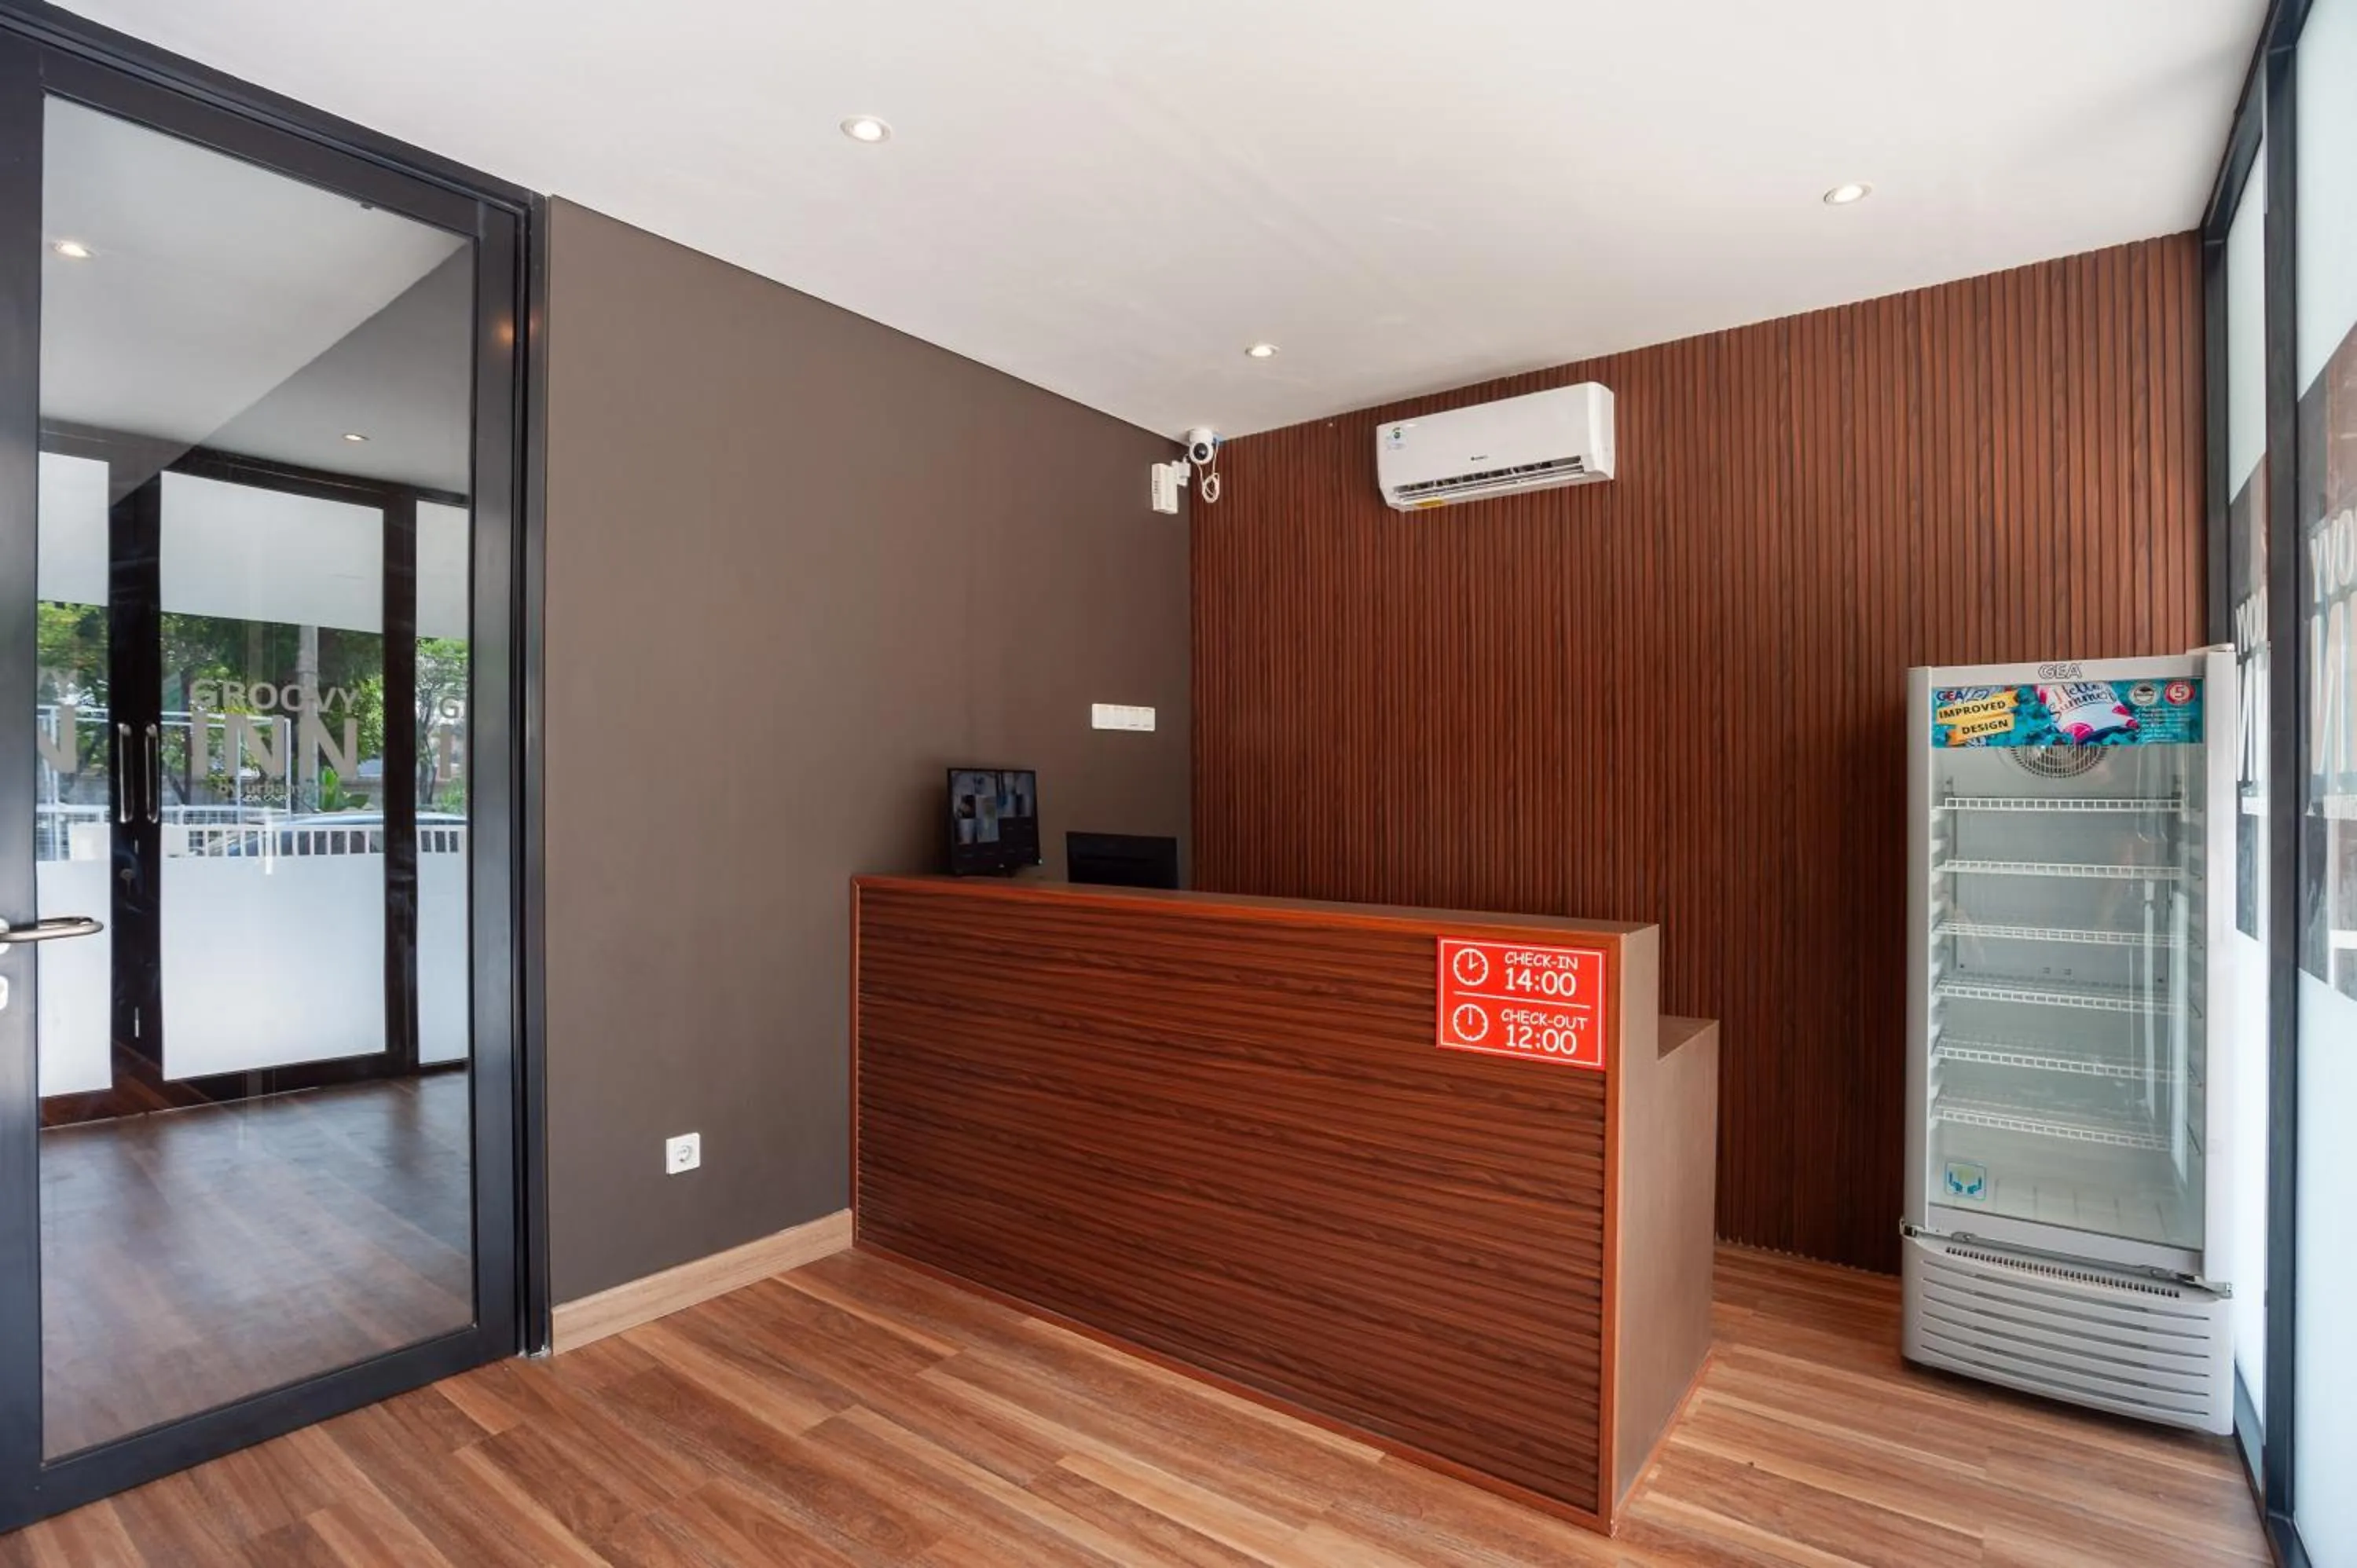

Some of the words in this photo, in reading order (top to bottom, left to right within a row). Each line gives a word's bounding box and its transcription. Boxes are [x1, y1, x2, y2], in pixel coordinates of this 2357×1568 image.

[2037, 662, 2084, 680] GEA
[189, 679, 359, 713] GROOVY
[1936, 690, 1964, 702] GEA
[1938, 700, 2006, 720] IMPROVED
[1962, 719, 2009, 735] DESIGN
[191, 709, 358, 780] INN
[1504, 951, 1578, 970] CHECK-IN
[1505, 967, 1577, 997] 14:00
[1501, 1008, 1589, 1031] CHECK-OUT
[1505, 1024, 1578, 1055] 12:00
